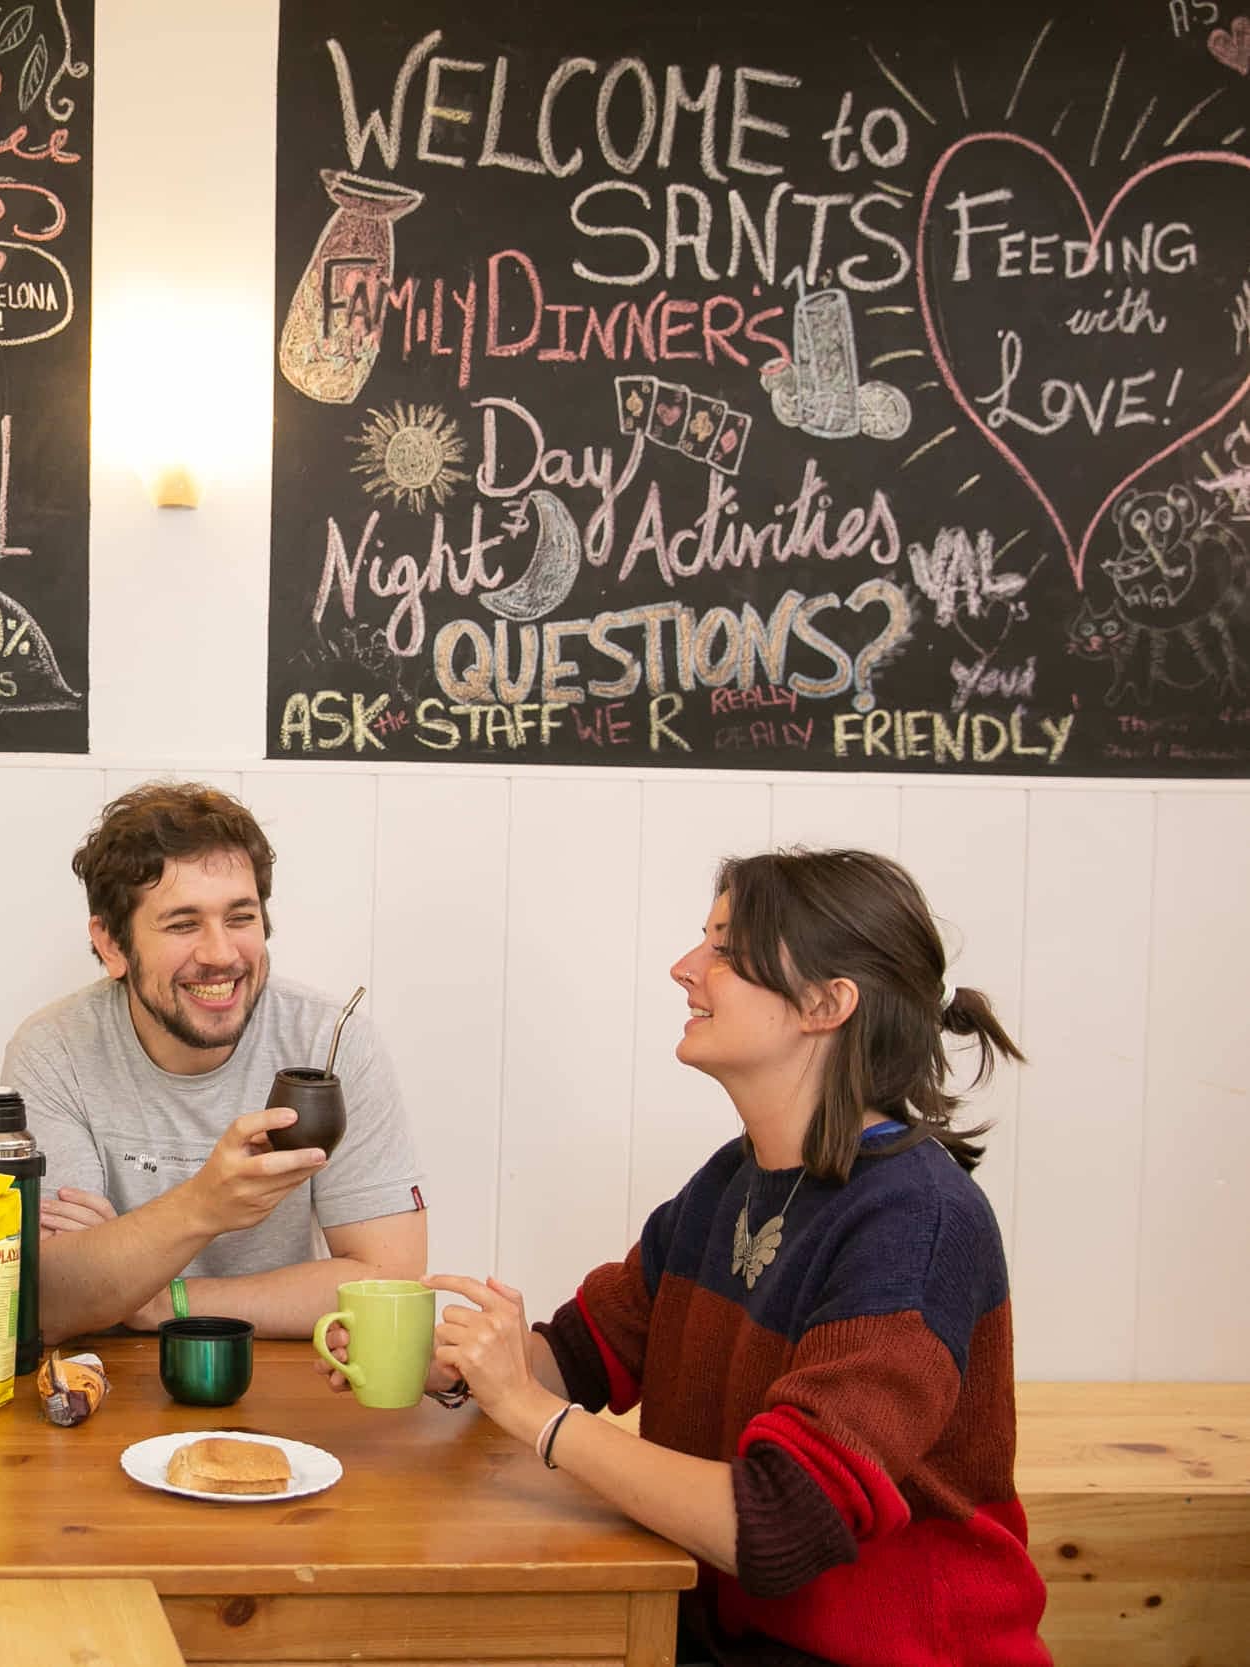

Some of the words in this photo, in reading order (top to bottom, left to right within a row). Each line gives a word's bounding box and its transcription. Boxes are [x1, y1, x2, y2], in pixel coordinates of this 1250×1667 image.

[326, 29, 802, 182] WELCOME
[822, 91, 910, 172] to
[571, 180, 911, 292] SANTS
[944, 188, 1197, 282] FEEDING
[1066, 287, 1166, 335] with
[471, 395, 645, 567] Day
[312, 503, 507, 658] Night
[620, 458, 901, 586] Activities
[433, 577, 915, 713] QUESTIONS?
[278, 690, 390, 753] ASK
[414, 699, 569, 753] STAFF
[572, 704, 634, 746] WE
[651, 694, 693, 754] R
[710, 684, 798, 716] REALLY
[833, 709, 1075, 765] FRIENDLY
